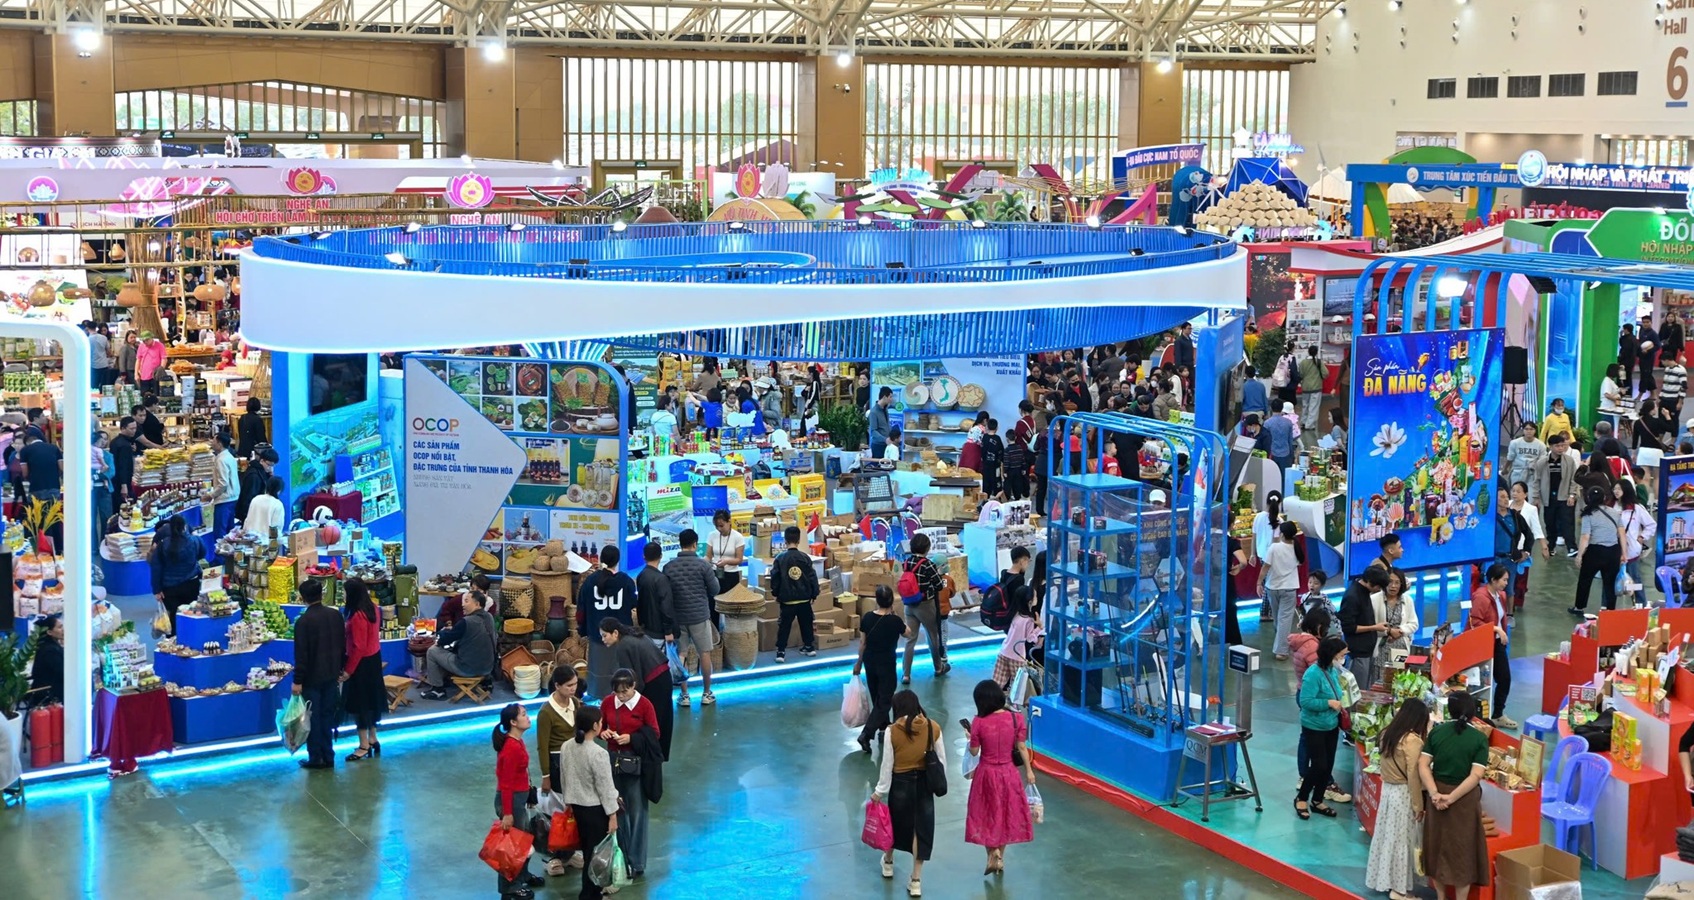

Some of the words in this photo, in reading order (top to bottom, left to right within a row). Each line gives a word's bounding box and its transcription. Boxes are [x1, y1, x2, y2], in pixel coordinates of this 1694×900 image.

[1664, 17, 1687, 35] Hall
[1667, 46, 1688, 100] 6
[1155, 151, 1168, 161] NAM
[1180, 146, 1199, 159] QUỐC
[1423, 171, 1444, 181] TRUNG
[1446, 169, 1460, 181] TÂM
[1461, 170, 1475, 181] XÚC
[1477, 170, 1492, 183] TIẾN
[1493, 171, 1507, 183] ĐẦU
[1571, 165, 1608, 184] NHẬP
[1610, 165, 1626, 182] VÀ
[1628, 166, 1665, 184] PHÁT
[316, 199, 329, 209] AN
[216, 210, 233, 224] HỘI
[235, 210, 255, 224] CHỢ
[257, 210, 284, 223] TRIỂN
[485, 215, 500, 225] AN
[1641, 240, 1660, 256] HỘI
[1663, 241, 1694, 256] NHẬP
[1363, 373, 1383, 397] ĐÀ
[1388, 369, 1427, 395] NẴNG
[412, 417, 459, 432] OCOP
[413, 440, 426, 449] CÁC
[427, 440, 440, 450] SẢN
[441, 440, 460, 450] PHẨM
[1518, 447, 1537, 455] BEAR
[413, 452, 430, 460] OCOP
[431, 451, 442, 461] NỔI
[413, 462, 426, 472] ĐẶC
[427, 464, 447, 473] TRƯNG
[449, 463, 462, 473] CỦA
[463, 463, 477, 473] TỈNH
[479, 465, 499, 475] THANH
[500, 464, 513, 475] HÓA
[1186, 740, 1207, 755] QCM
